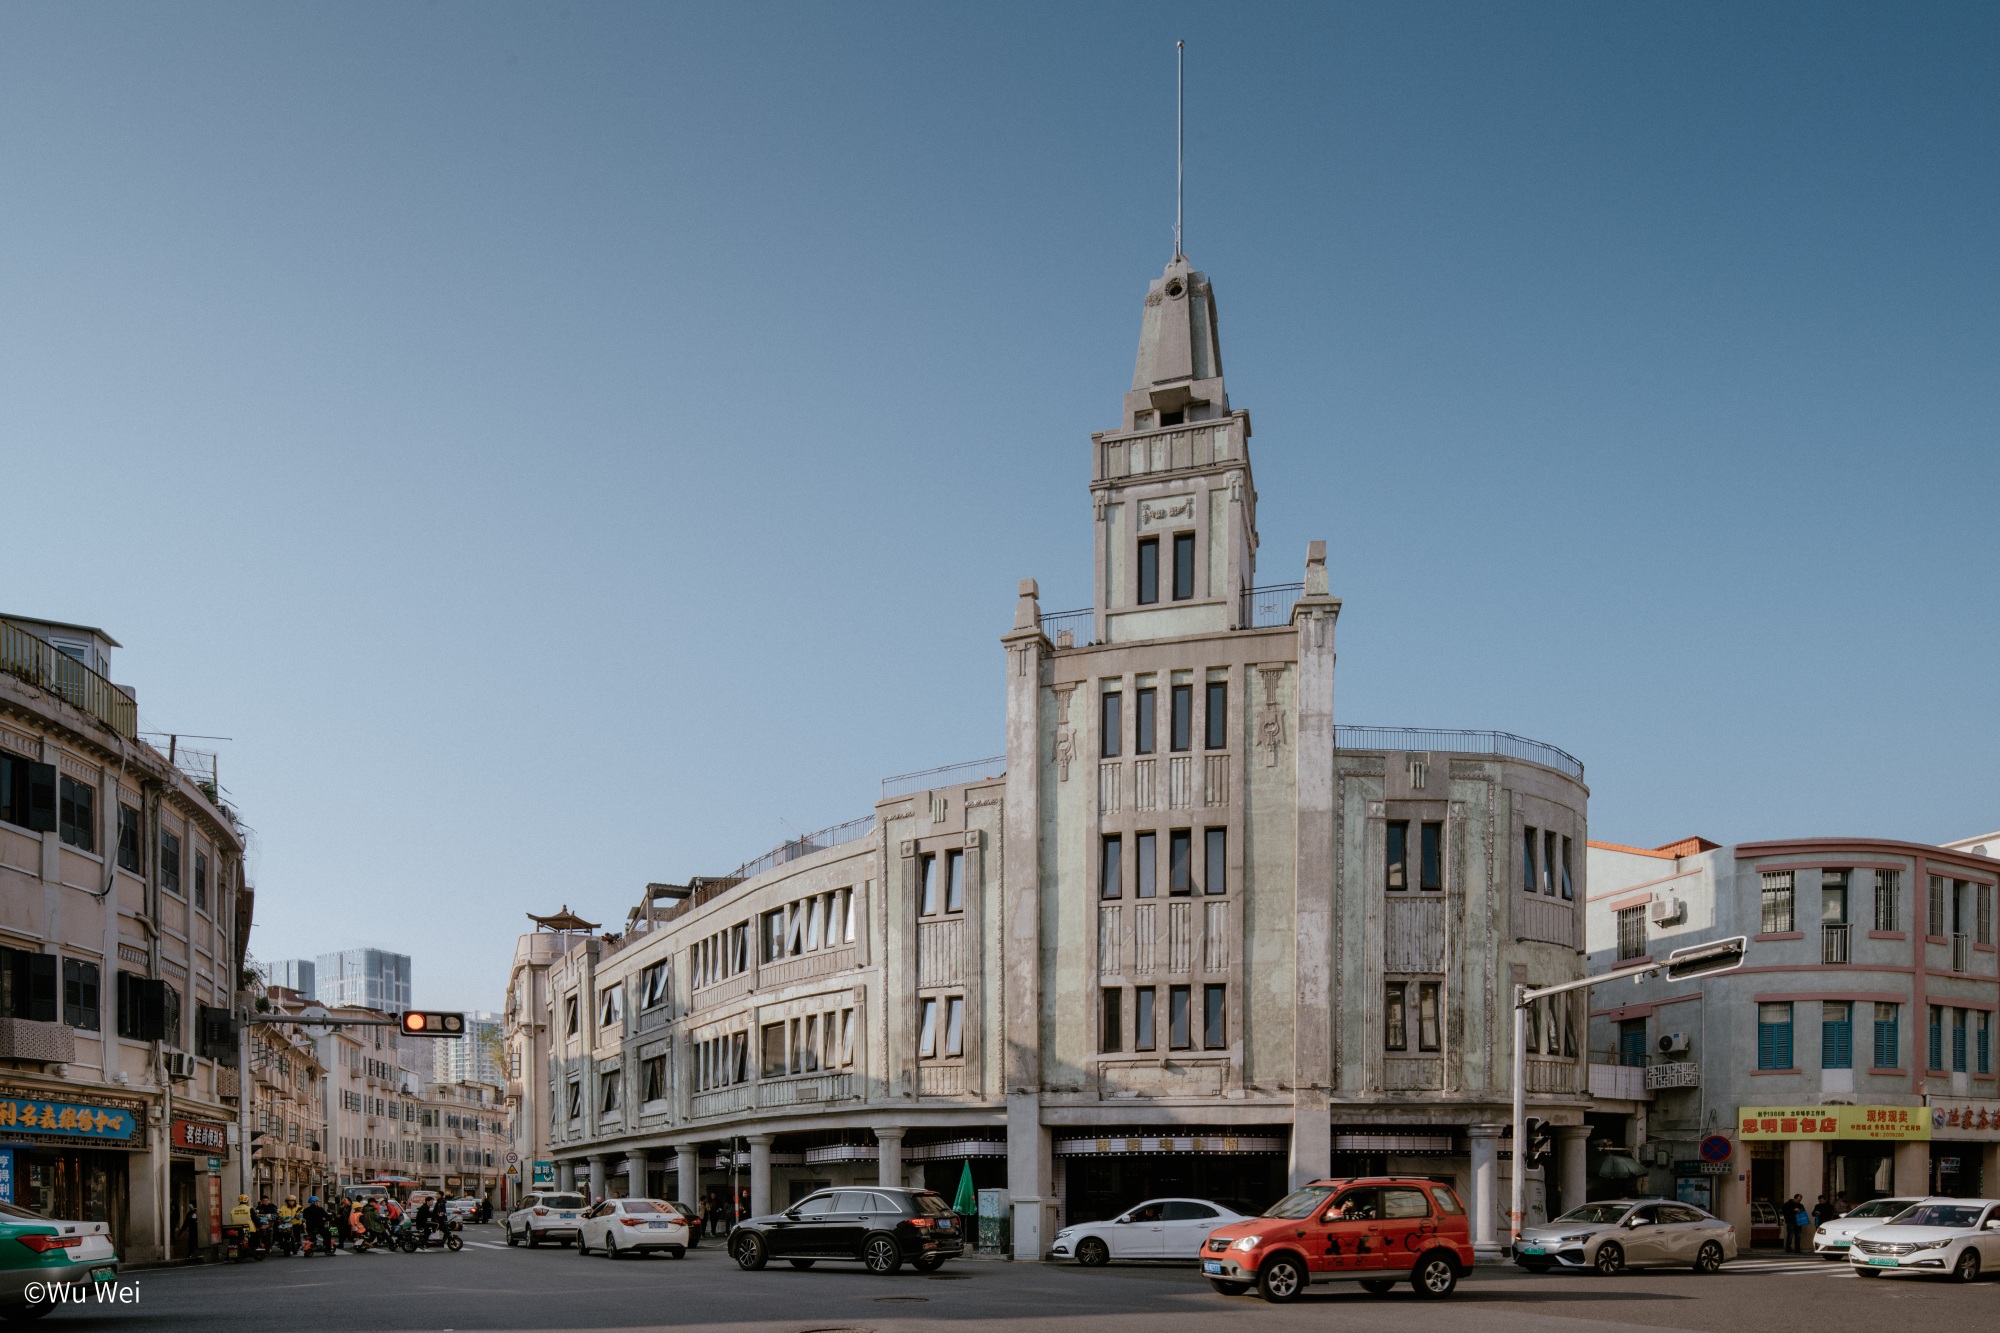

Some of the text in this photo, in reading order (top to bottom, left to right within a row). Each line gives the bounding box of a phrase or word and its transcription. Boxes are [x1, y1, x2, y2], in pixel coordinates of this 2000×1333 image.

[1867, 1110, 1908, 1123] 现烤现卖
[1742, 1117, 1837, 1133] 思明面包店
[1097, 1138, 1237, 1152] 思明电影院
